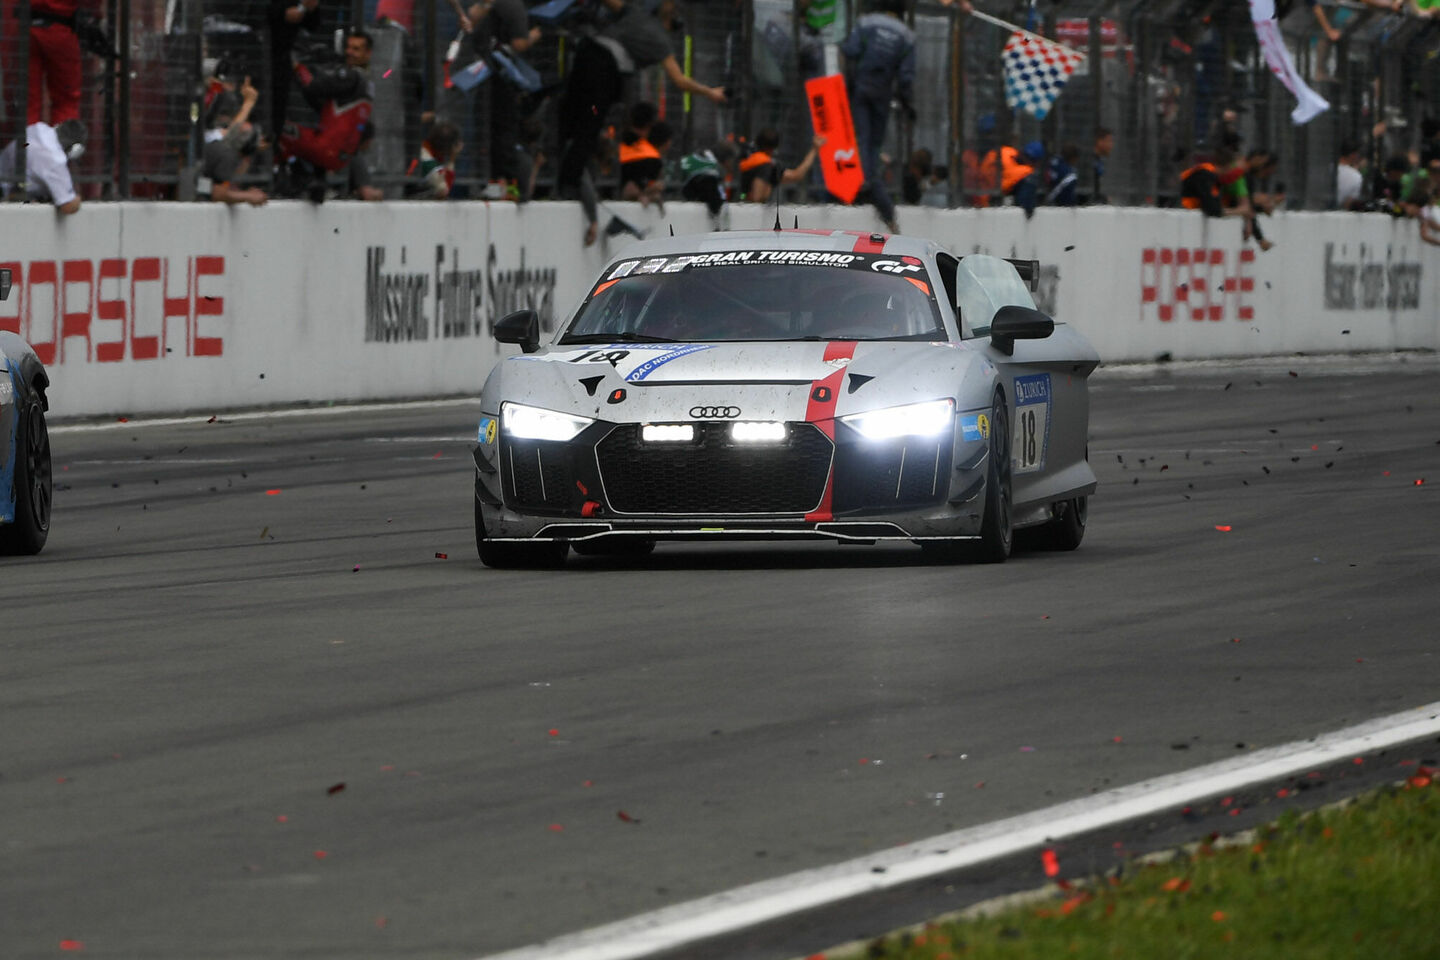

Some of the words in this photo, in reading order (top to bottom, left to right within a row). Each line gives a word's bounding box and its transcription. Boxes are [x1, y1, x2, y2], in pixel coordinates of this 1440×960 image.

[691, 252, 748, 264] GRAN
[756, 251, 857, 264] TURISMO
[1140, 247, 1257, 323] PORSCHE
[1022, 380, 1047, 398] ZURICH
[1021, 409, 1036, 468] 18
